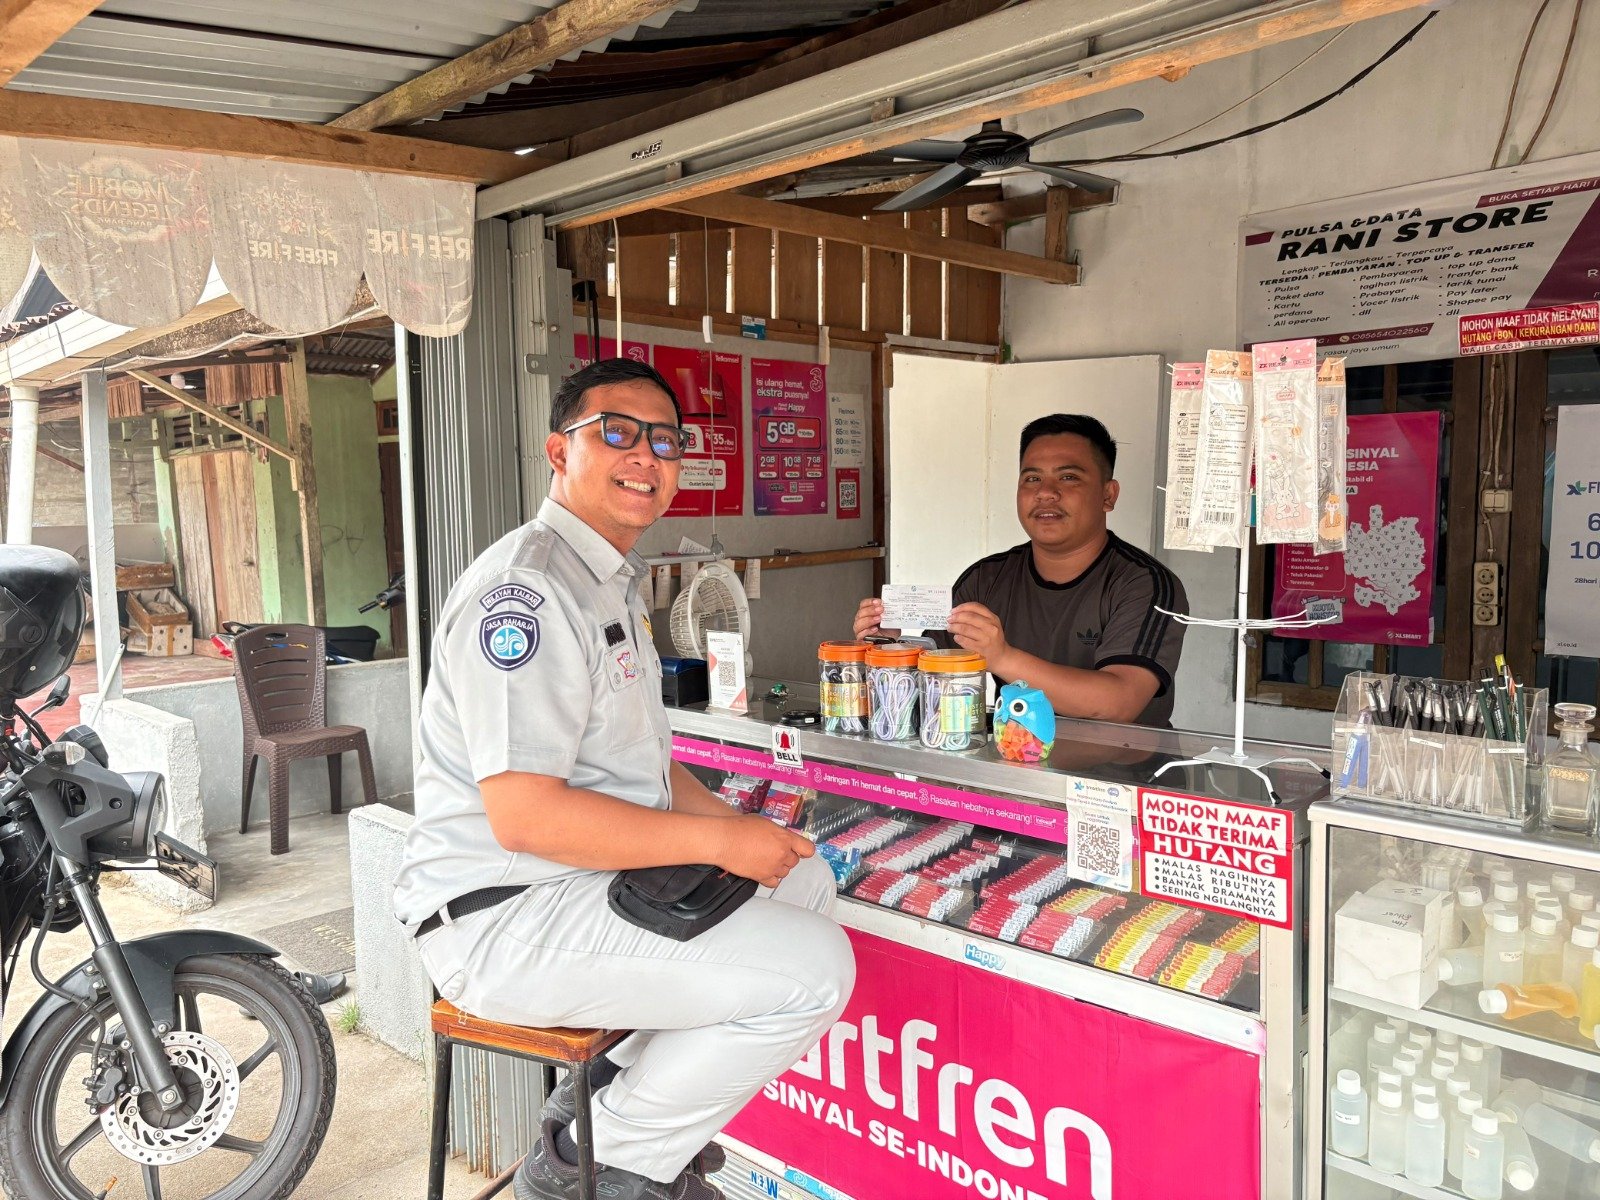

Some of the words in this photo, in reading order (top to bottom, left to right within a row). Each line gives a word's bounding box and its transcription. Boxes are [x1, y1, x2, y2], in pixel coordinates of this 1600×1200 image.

[1489, 192, 1518, 203] BUKA
[1521, 186, 1560, 198] SETIAP
[1562, 181, 1590, 191] HARI
[1276, 228, 1382, 262] RANI
[1392, 200, 1553, 243] STORE
[1281, 221, 1343, 239] PULSA
[1259, 274, 1309, 286] TERSEDIA
[1318, 261, 1395, 277] PEMBAYARAN
[1406, 256, 1431, 265] TOP
[1433, 253, 1451, 262] UP
[1468, 241, 1535, 256] TRANSFER
[1282, 264, 1319, 275] Lengkap
[1330, 255, 1384, 268] Terjangkau
[1396, 244, 1454, 259] Terpercaya
[1448, 263, 1465, 271] top
[1487, 256, 1516, 264] dana
[1360, 267, 1424, 281] Pembayaran
[1491, 264, 1519, 273] bank
[1274, 285, 1300, 293] Pulsa
[1360, 280, 1396, 290] tagihan
[1400, 275, 1429, 284] listrik
[1446, 279, 1473, 288] tarik
[1477, 275, 1506, 284] tunai
[1274, 293, 1301, 302] Paket
[1303, 290, 1324, 298] data
[1360, 287, 1406, 298] Prabayar
[1391, 294, 1420, 303] listrik
[1446, 290, 1467, 298] Pay
[1471, 286, 1498, 294] later
[1447, 298, 1487, 307] Shopee
[1490, 293, 1512, 302] pay
[1273, 309, 1313, 319] perdana
[1288, 316, 1330, 326] operator
[1462, 318, 1494, 332] MOHON
[1495, 316, 1521, 329] MAAF
[1522, 310, 1550, 326] TIDAK
[1551, 307, 1597, 322] MELAYANI
[1462, 331, 1492, 344] HUTANG
[1497, 328, 1513, 339] BON
[1519, 324, 1572, 338] KEKURANGAN
[1574, 322, 1597, 333] DANA
[1349, 346, 1368, 355] jaya
[1371, 344, 1400, 352] umum
[1462, 344, 1491, 354] WAJIB
[1528, 335, 1597, 347] TERIMAKASIH
[764, 379, 783, 388] ulang
[756, 388, 783, 398] ekstra
[1345, 447, 1399, 459] SINYAL
[1346, 461, 1379, 471] ESIA
[485, 588, 512, 606] WILAYAH
[513, 588, 538, 605] KALBAR
[486, 619, 502, 631] JASA
[502, 618, 533, 632] RAHARJA
[721, 752, 742, 764] Rasakan
[776, 751, 799, 763] BELL
[823, 773, 850, 786] Jaringan
[851, 778, 860, 786] Tri
[860, 781, 882, 791] hemat
[883, 785, 896, 795] dan
[930, 795, 960, 808] Rasakan
[961, 801, 995, 816] hebatnya
[995, 809, 1033, 825] sekarang!
[1146, 797, 1219, 822] MOHON
[1225, 810, 1281, 831] MAAF
[1148, 814, 1203, 837] TIDAK
[1207, 824, 1279, 850] TERIMA
[1153, 833, 1276, 875] HUTANG
[1162, 858, 1201, 872] MALAS
[1210, 868, 1276, 888] NAGIHNYA
[1162, 867, 1203, 882] MALAS
[1211, 877, 1276, 898] RIBUTNYA
[1162, 876, 1205, 892] BANYAK
[1213, 886, 1276, 908] DRAMANYA
[1162, 885, 1200, 900] SERING
[1203, 893, 1276, 918] NGILANGNYA
[965, 944, 1006, 970] Happy
[762, 1078, 862, 1138] SINYAL
